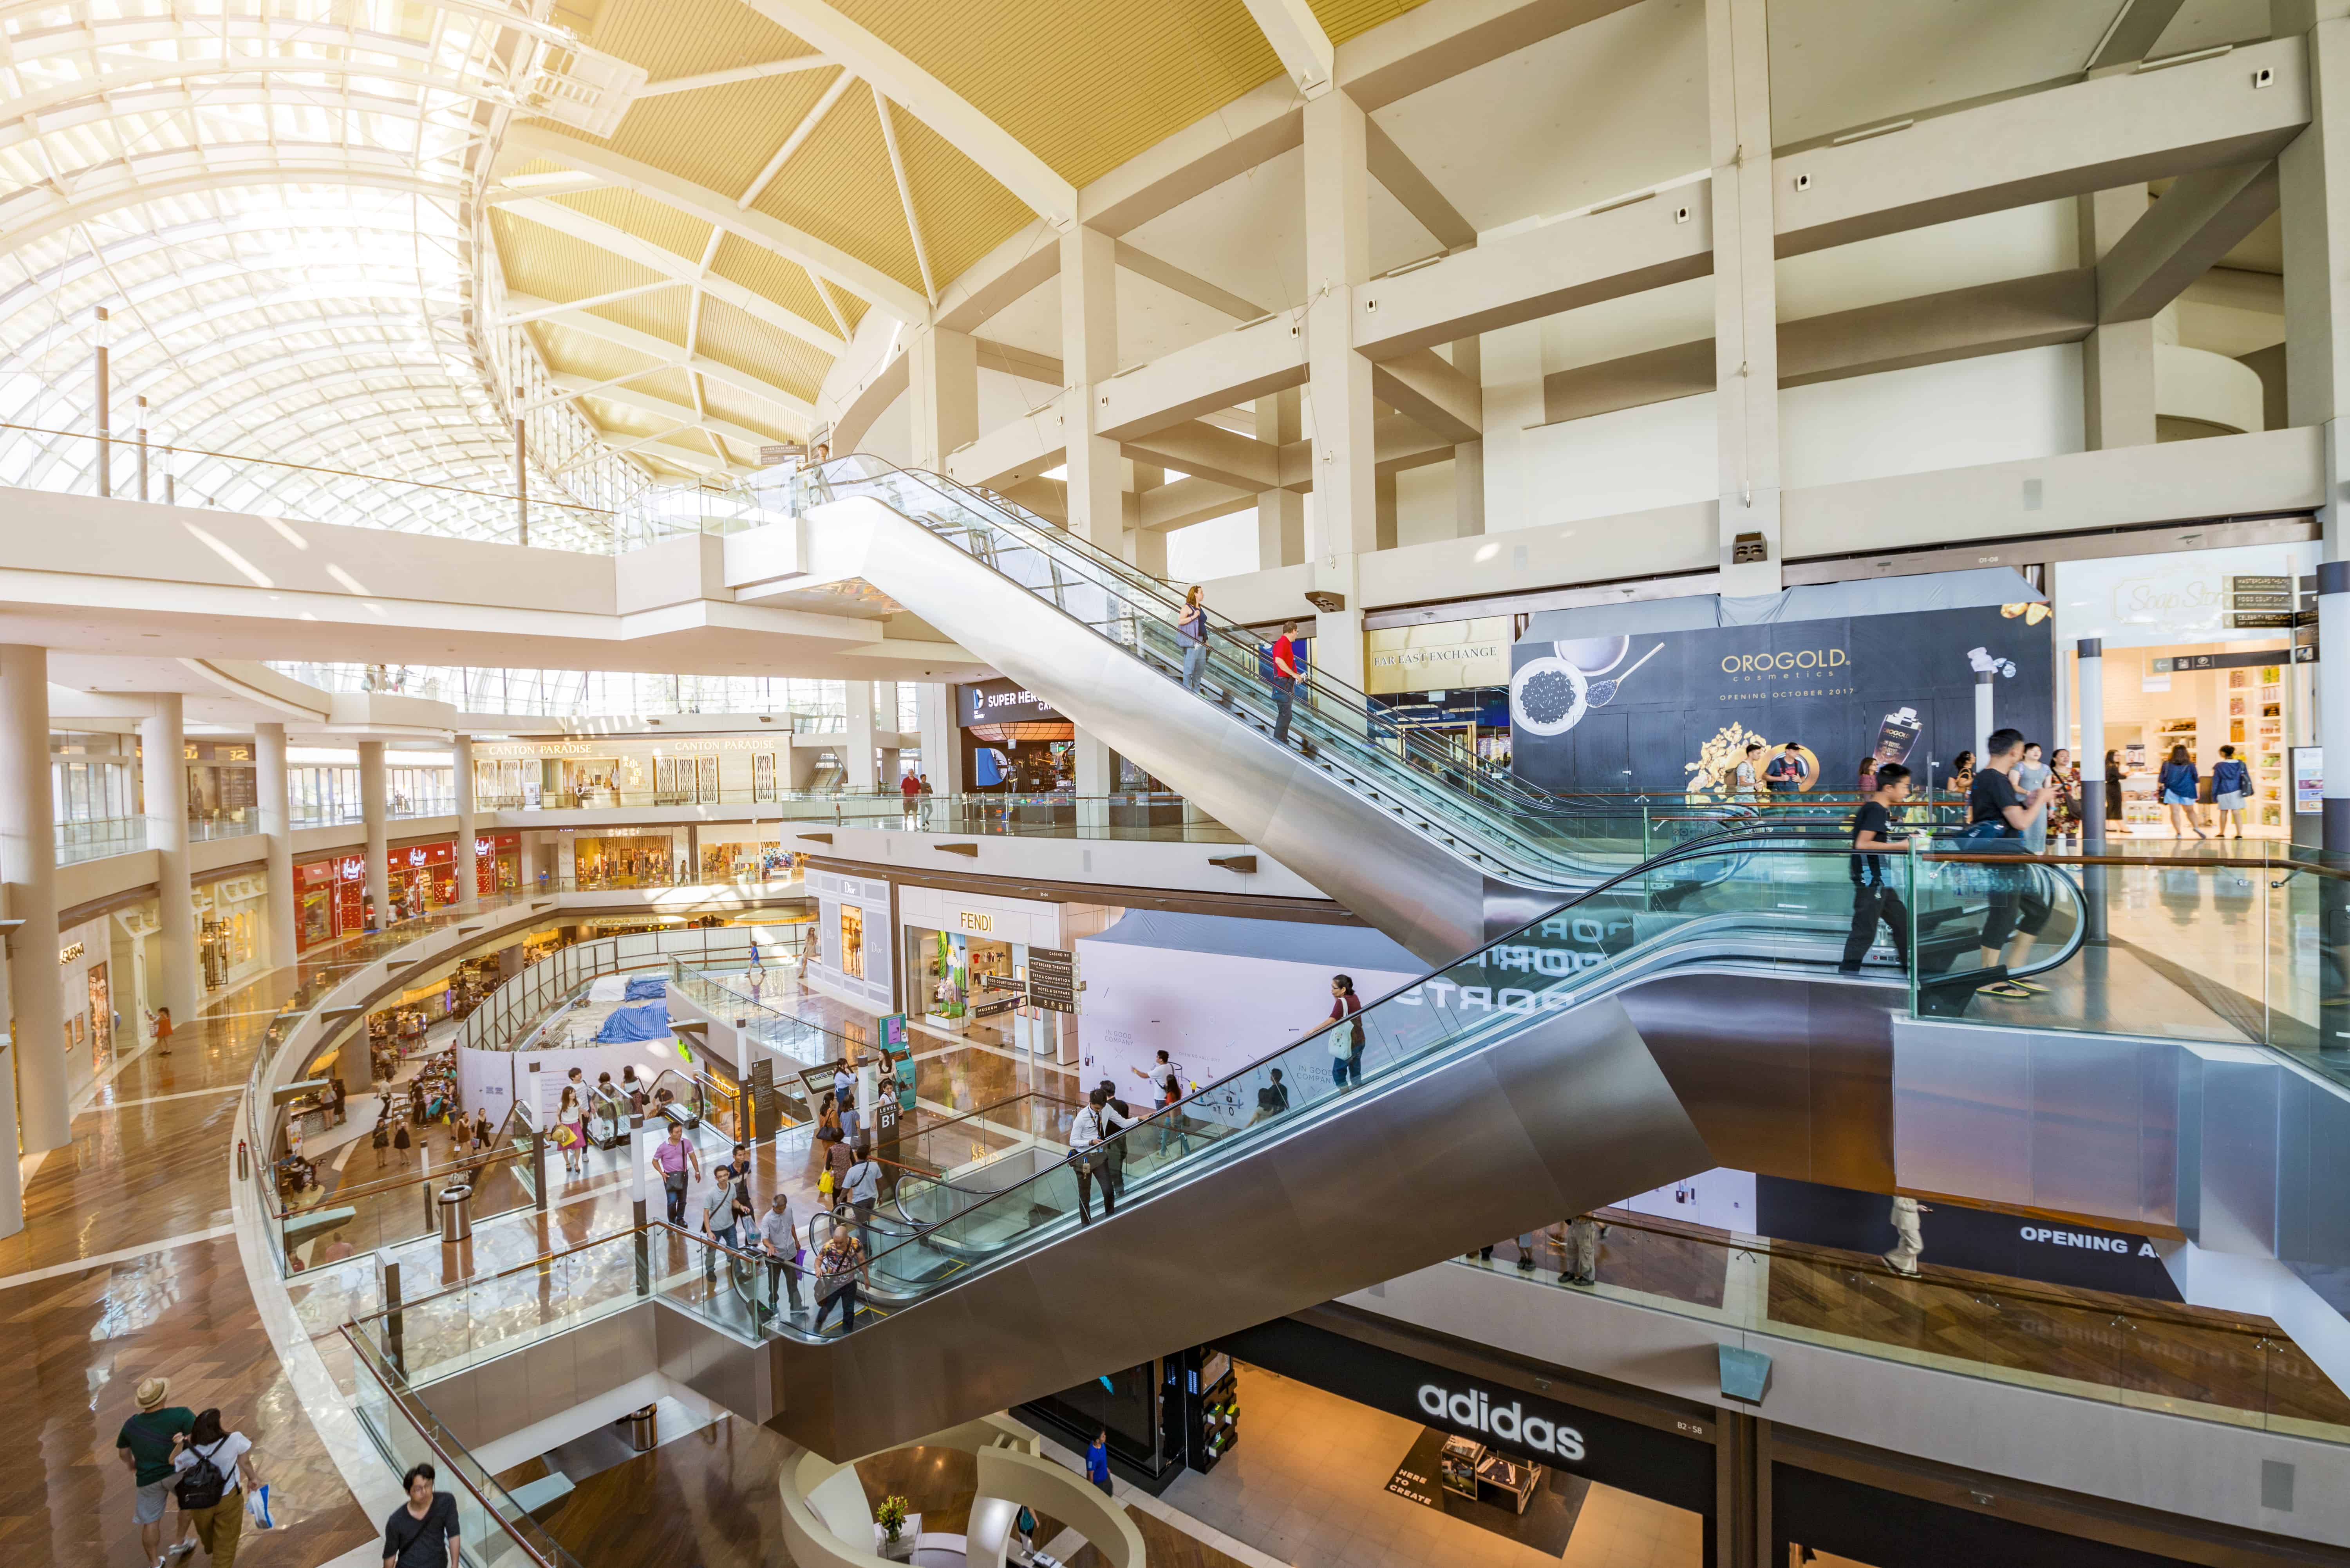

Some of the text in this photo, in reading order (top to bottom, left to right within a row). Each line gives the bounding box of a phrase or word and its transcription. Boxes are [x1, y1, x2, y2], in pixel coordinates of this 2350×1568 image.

[1374, 647, 1497, 666] FAR EAST EXCHANGE
[1721, 649, 1846, 673] OROGOLD
[1733, 670, 1833, 682] cosmetics
[988, 692, 1017, 708] SUPER
[1772, 690, 1822, 698] OCTOBER
[489, 744, 592, 756] CANTON PARADISE
[675, 740, 774, 751] CANTON PARADISE
[844, 882, 856, 894] Dior
[961, 912, 993, 932] FENDI
[871, 941, 884, 956] Dior
[1104, 1036, 1134, 1046] COMPANY
[1114, 1031, 1132, 1039] GOOD
[1309, 1067, 1332, 1076] GOOD
[880, 1104, 897, 1113] LEVEL
[882, 1113, 895, 1128] B1
[2020, 1227, 2160, 1258] OPENING A
[1418, 1384, 1585, 1460] adidas
[1395, 1476, 1409, 1486] TO
[1399, 1469, 1427, 1484] HERE
[1390, 1484, 1432, 1505] CREATE
